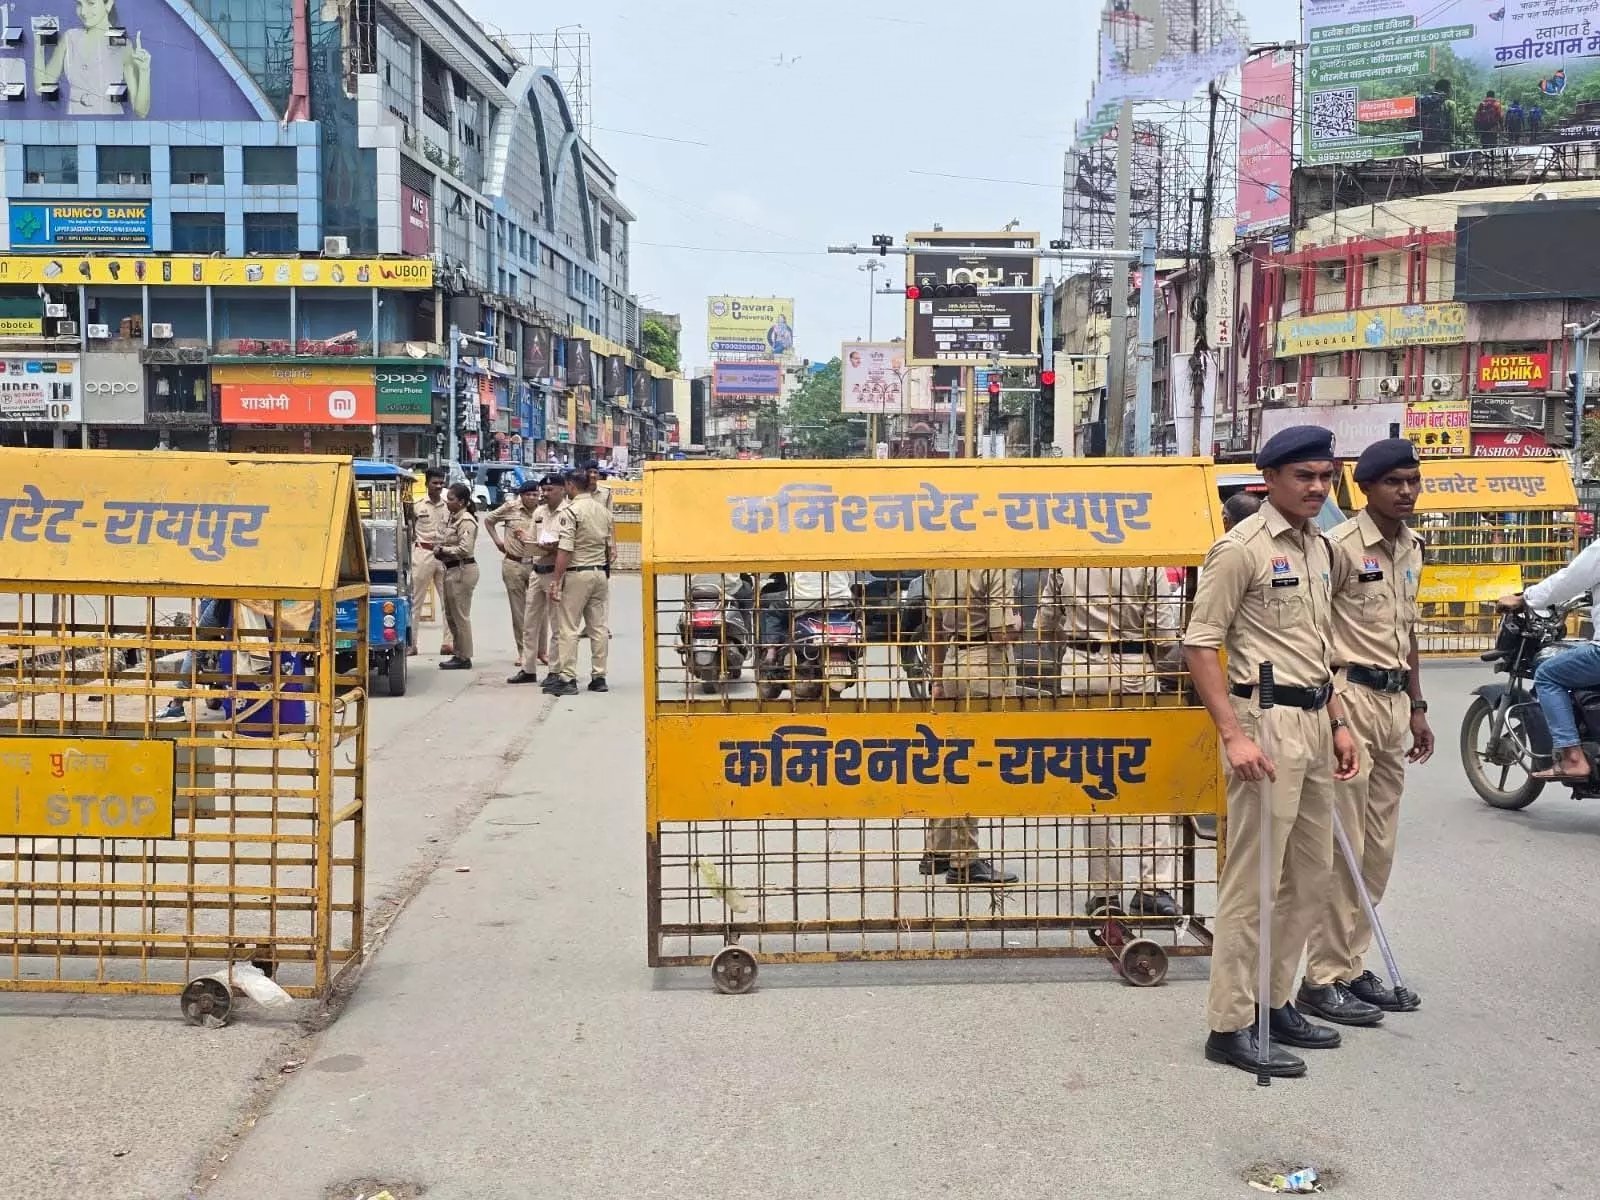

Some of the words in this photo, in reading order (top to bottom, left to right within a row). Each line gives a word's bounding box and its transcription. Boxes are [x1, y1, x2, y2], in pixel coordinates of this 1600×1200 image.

[1535, 24, 1580, 40] स्वागत
[1582, 18, 1592, 36] है
[1494, 38, 1584, 62] कबीरधाम
[53, 208, 102, 219] RUMCO
[107, 208, 146, 219] BANK
[731, 302, 774, 312] Davara
[732, 312, 774, 322] University
[1299, 335, 1357, 349] LUGGAGE
[1491, 357, 1535, 367] HOTEL
[376, 374, 427, 384] oppo
[1482, 366, 1543, 382] RADHIKA
[84, 381, 138, 396] oppo
[240, 394, 291, 411] शाओमी
[1484, 398, 1515, 406] Campus
[1474, 445, 1521, 457] FASHION
[1522, 444, 1557, 457] SHOE
[45, 794, 157, 828] STOP
